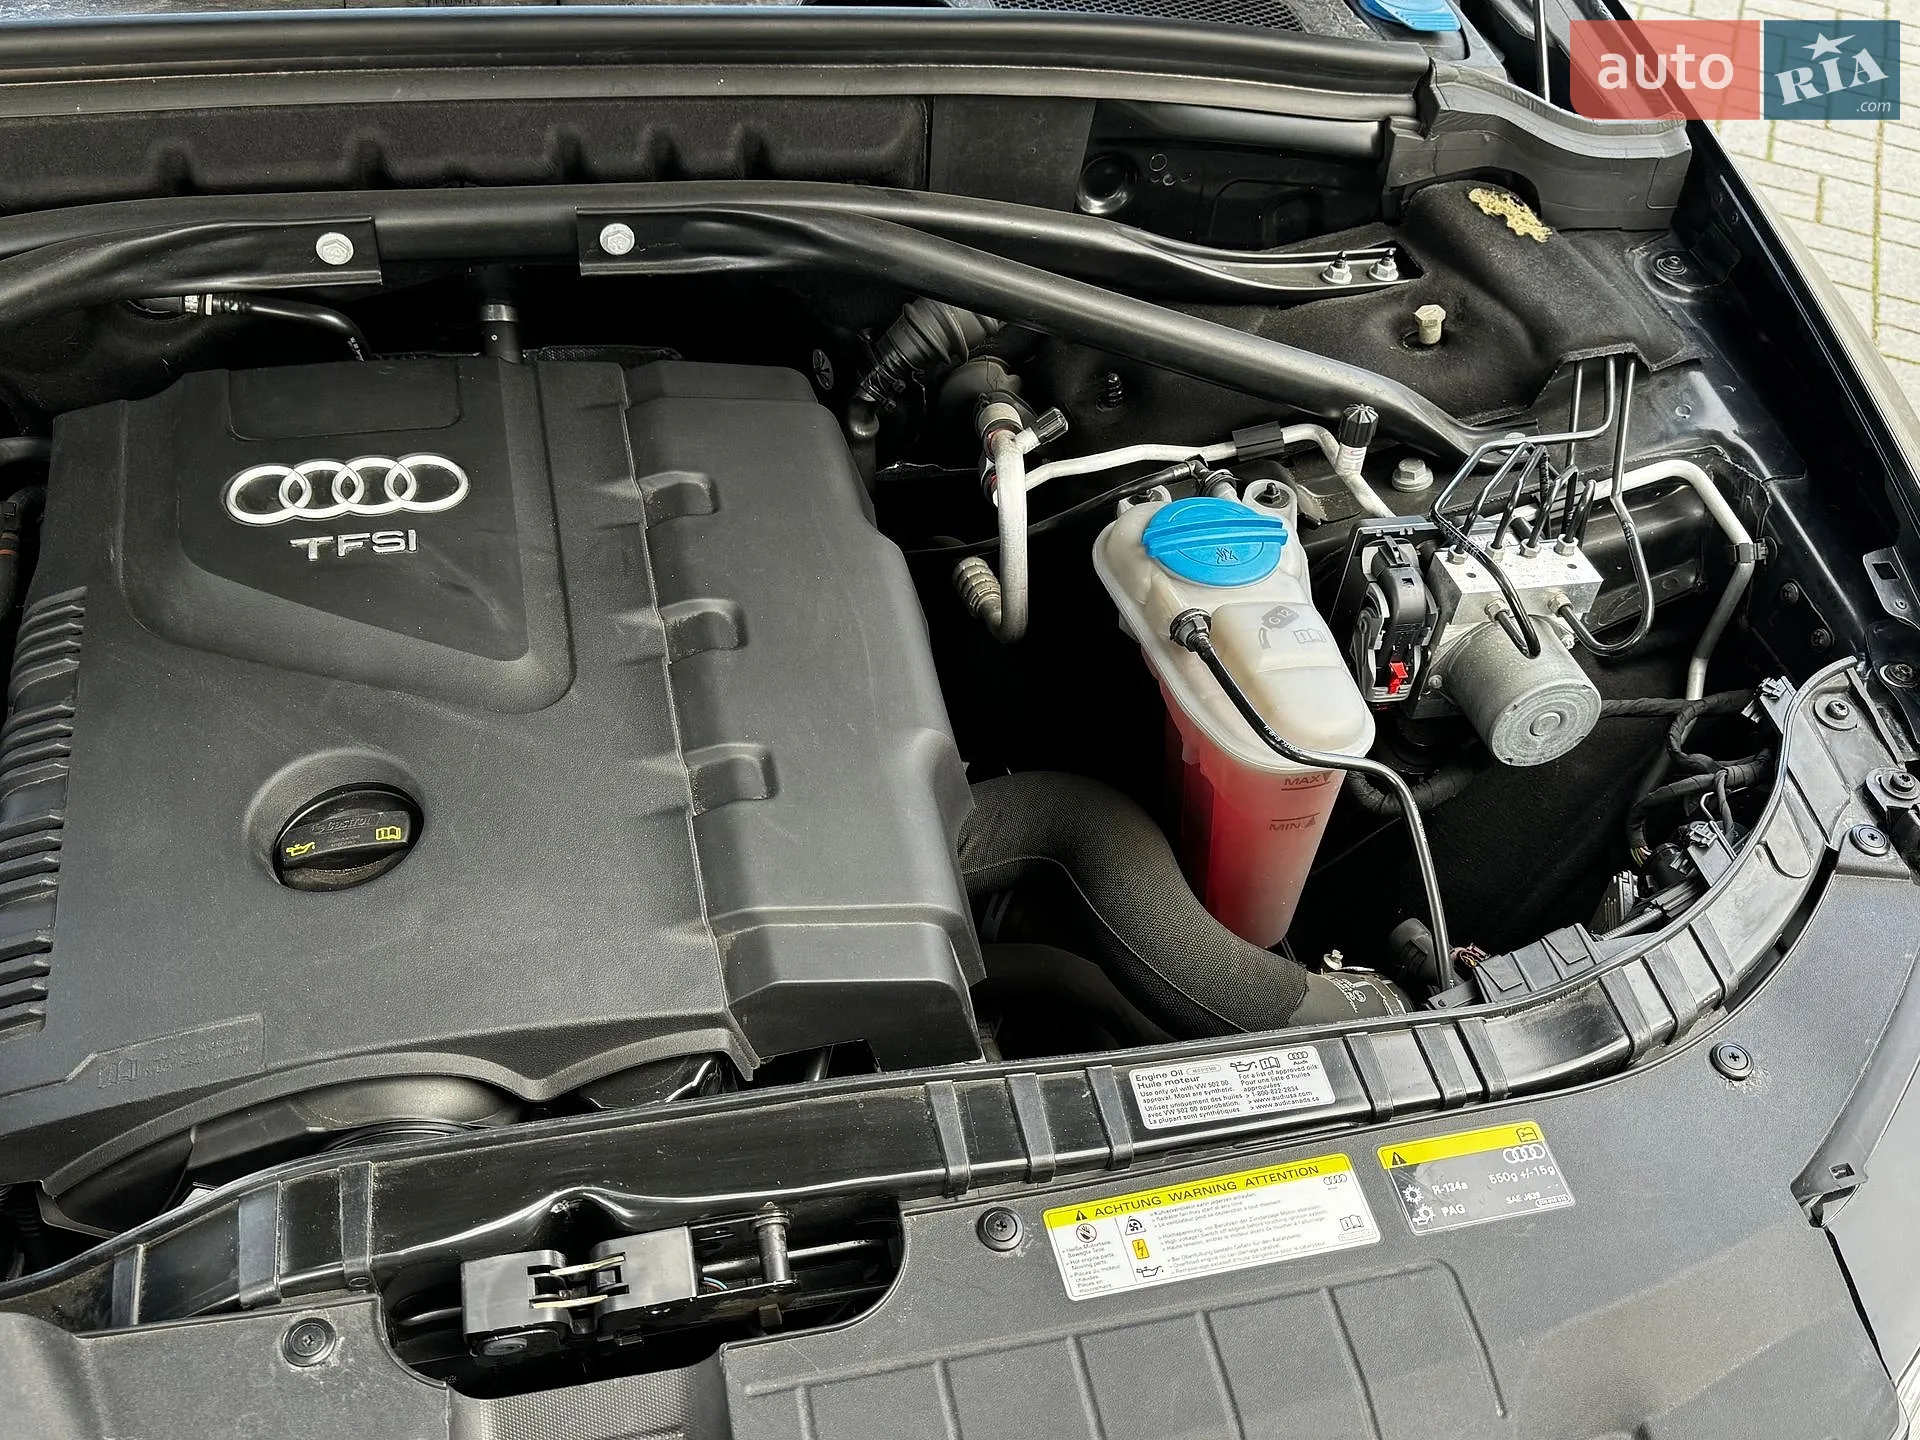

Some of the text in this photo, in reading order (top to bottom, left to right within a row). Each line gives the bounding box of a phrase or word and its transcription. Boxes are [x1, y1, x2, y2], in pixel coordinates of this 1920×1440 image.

[290, 529, 417, 561] TFSI
[1284, 774, 1321, 786] MAX
[1268, 822, 1301, 831] MIN
[1136, 1071, 1168, 1082] Engine
[1138, 1075, 1201, 1089] Huile moteur
[1223, 1092, 1243, 1100] huiles
[1488, 1170, 1519, 1185] 550g
[1094, 1195, 1162, 1218] ACHTUNG
[1168, 1181, 1238, 1202] WARNING
[1245, 1165, 1319, 1188] ATTENTION
[1431, 1179, 1469, 1195] R-134a
[1505, 1194, 1522, 1204] SAE
[1441, 1203, 1466, 1217] PAG
